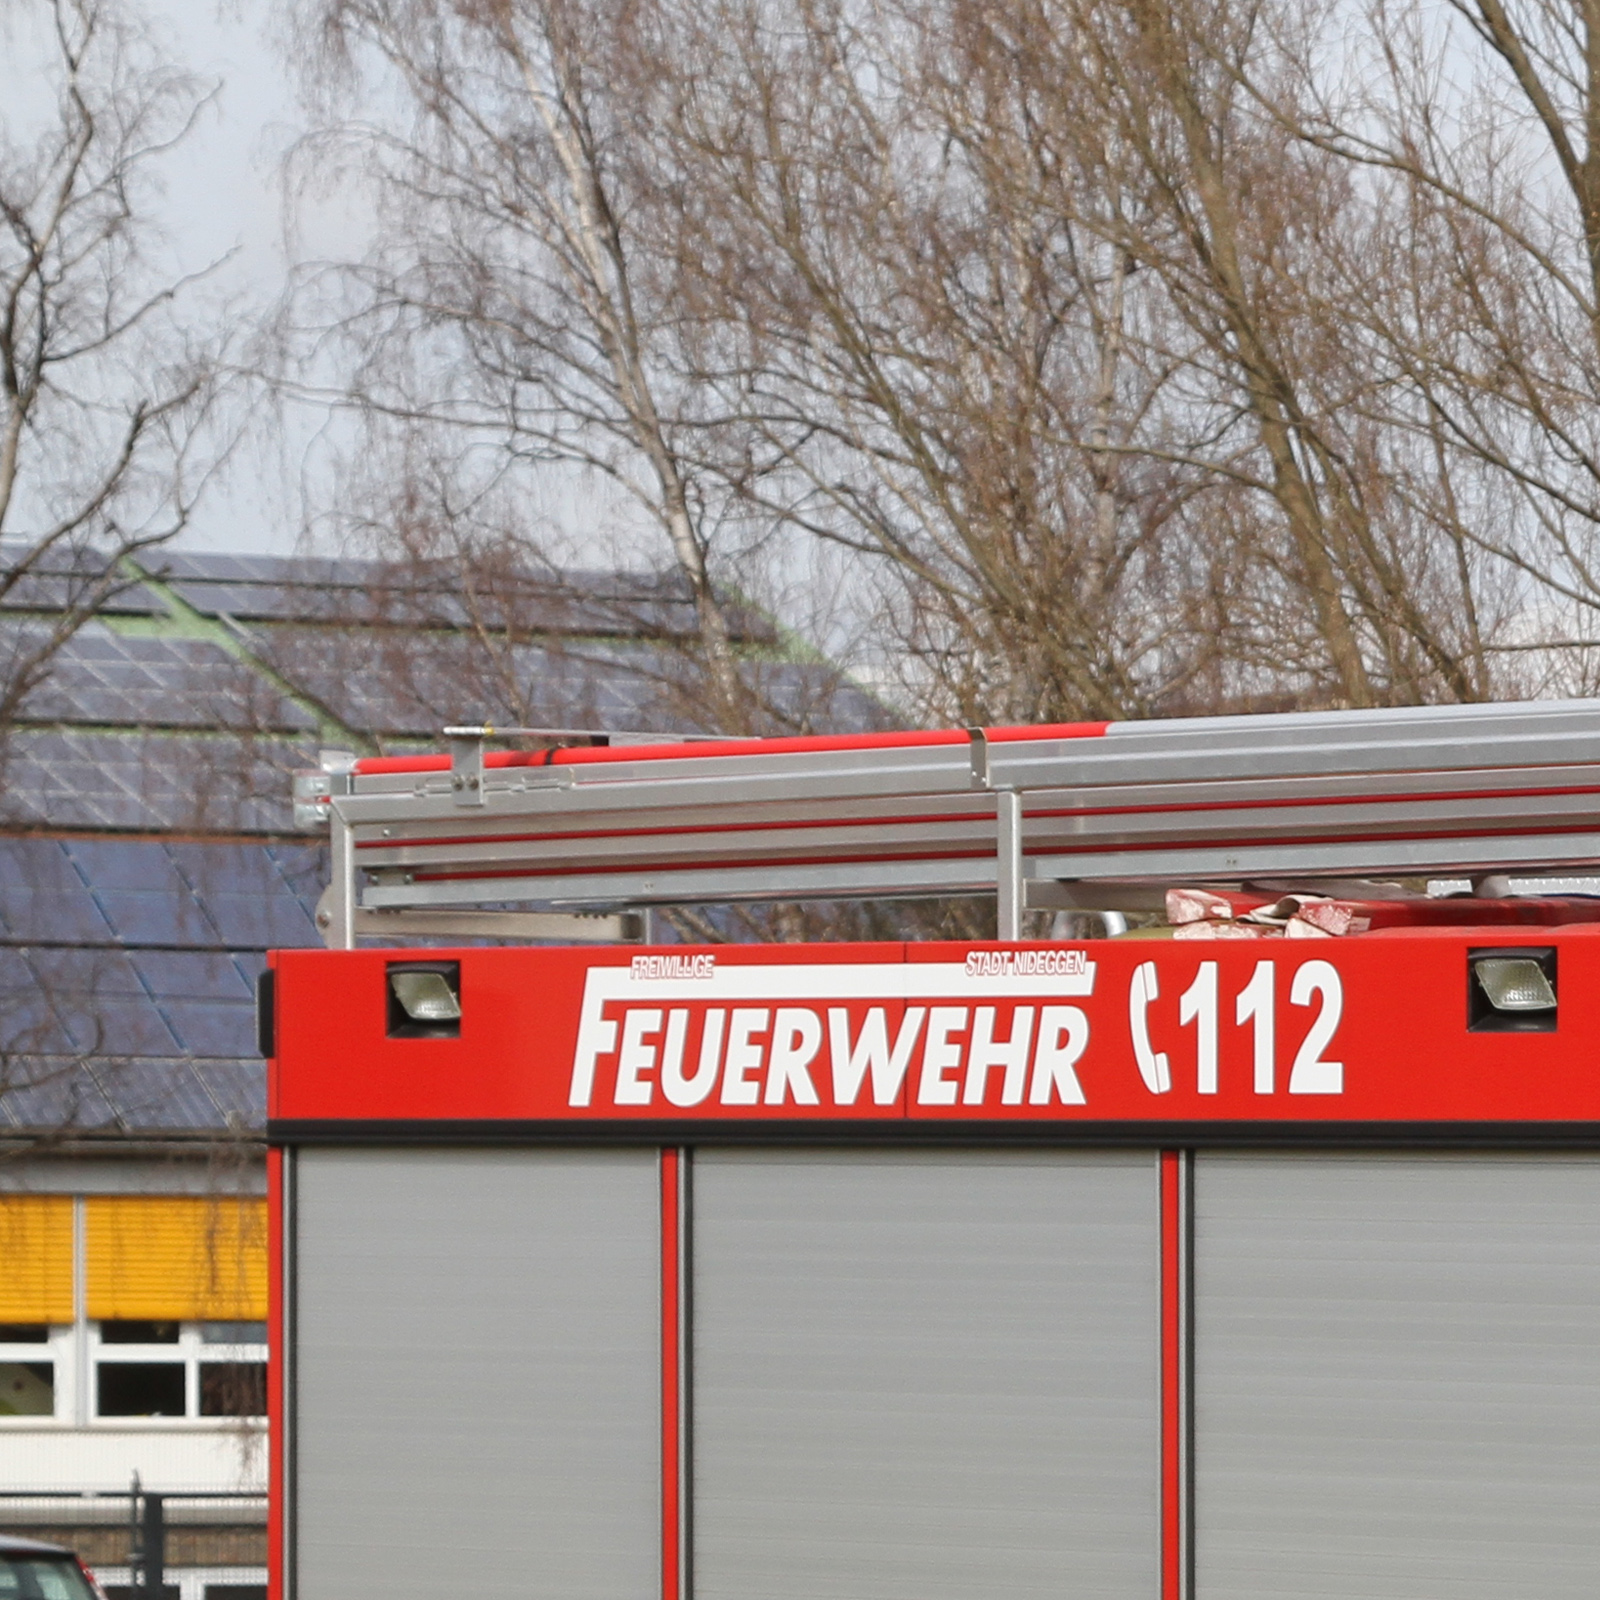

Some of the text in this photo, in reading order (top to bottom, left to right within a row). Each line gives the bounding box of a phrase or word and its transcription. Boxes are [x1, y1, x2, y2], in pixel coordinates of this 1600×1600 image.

[630, 955, 715, 980] FREIWILLIGE
[965, 949, 1087, 976] STADT NIDEGGEN
[568, 961, 1097, 1107] FEUERWEHR
[1178, 960, 1344, 1095] 112
